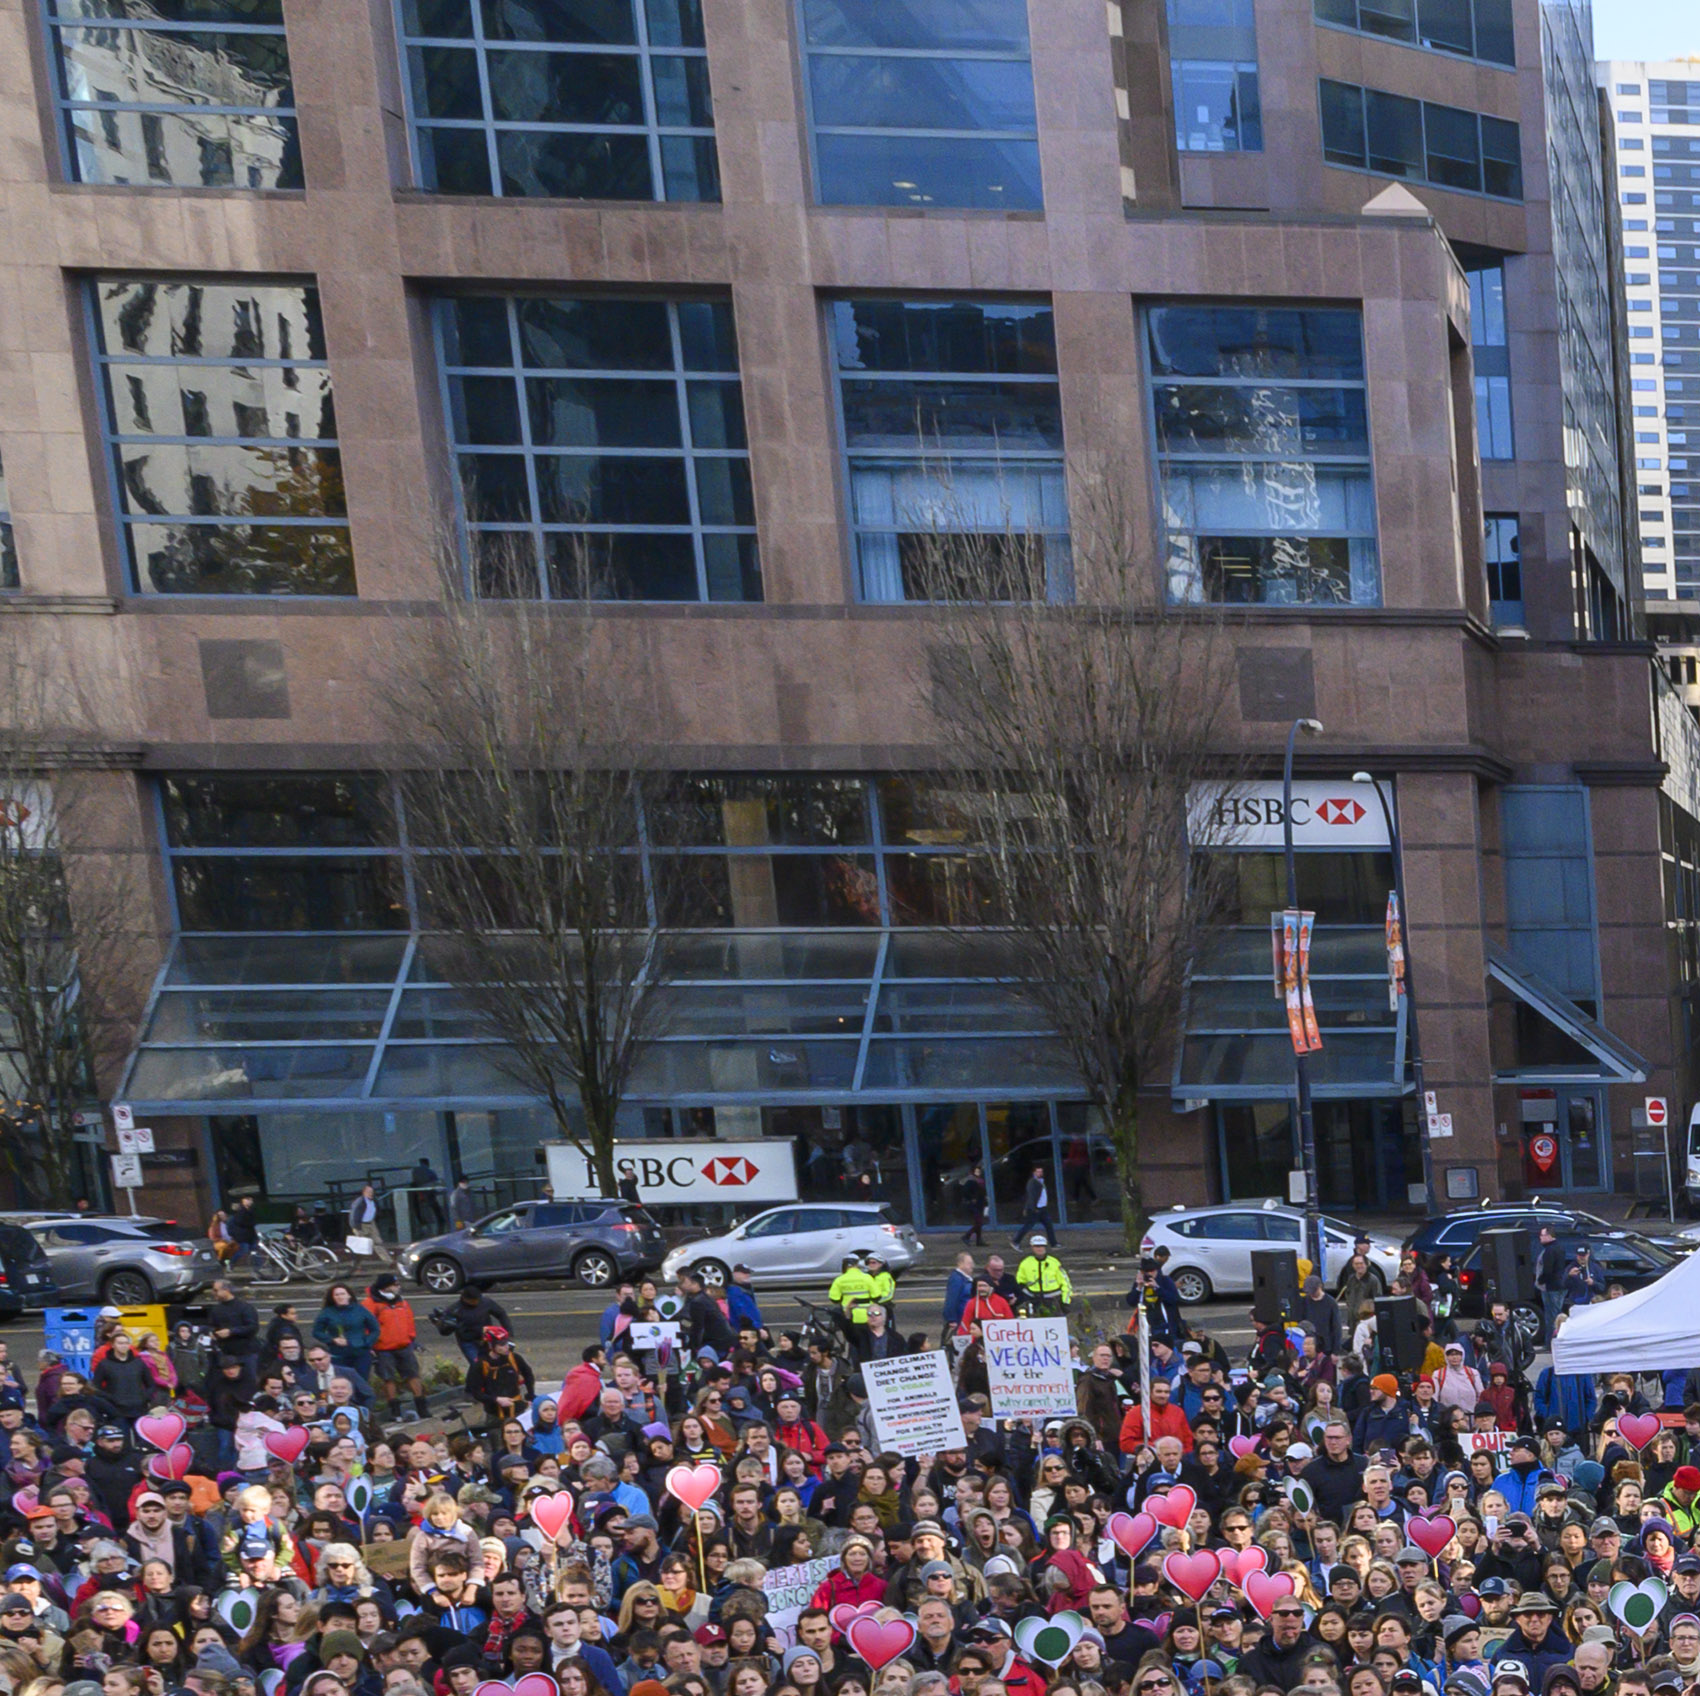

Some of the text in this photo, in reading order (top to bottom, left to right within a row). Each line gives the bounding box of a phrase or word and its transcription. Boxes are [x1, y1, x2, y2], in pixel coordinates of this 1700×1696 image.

[1214, 797, 1311, 826] HSBC
[986, 1322, 1034, 1342] Greta
[1045, 1327, 1058, 1340] is
[869, 1353, 937, 1369] FIGHT CLIMATE
[990, 1345, 1060, 1367] VEGAN
[874, 1363, 937, 1378] CHANGE WITH
[1002, 1368, 1043, 1379] for the
[876, 1378, 895, 1387] DIET
[991, 1380, 1069, 1395] environment
[904, 1392, 937, 1401] ANIMALS
[898, 1406, 950, 1419] ENVIRONMENT
[913, 1423, 942, 1431] HEALTH
[765, 1564, 809, 1590] HERE
